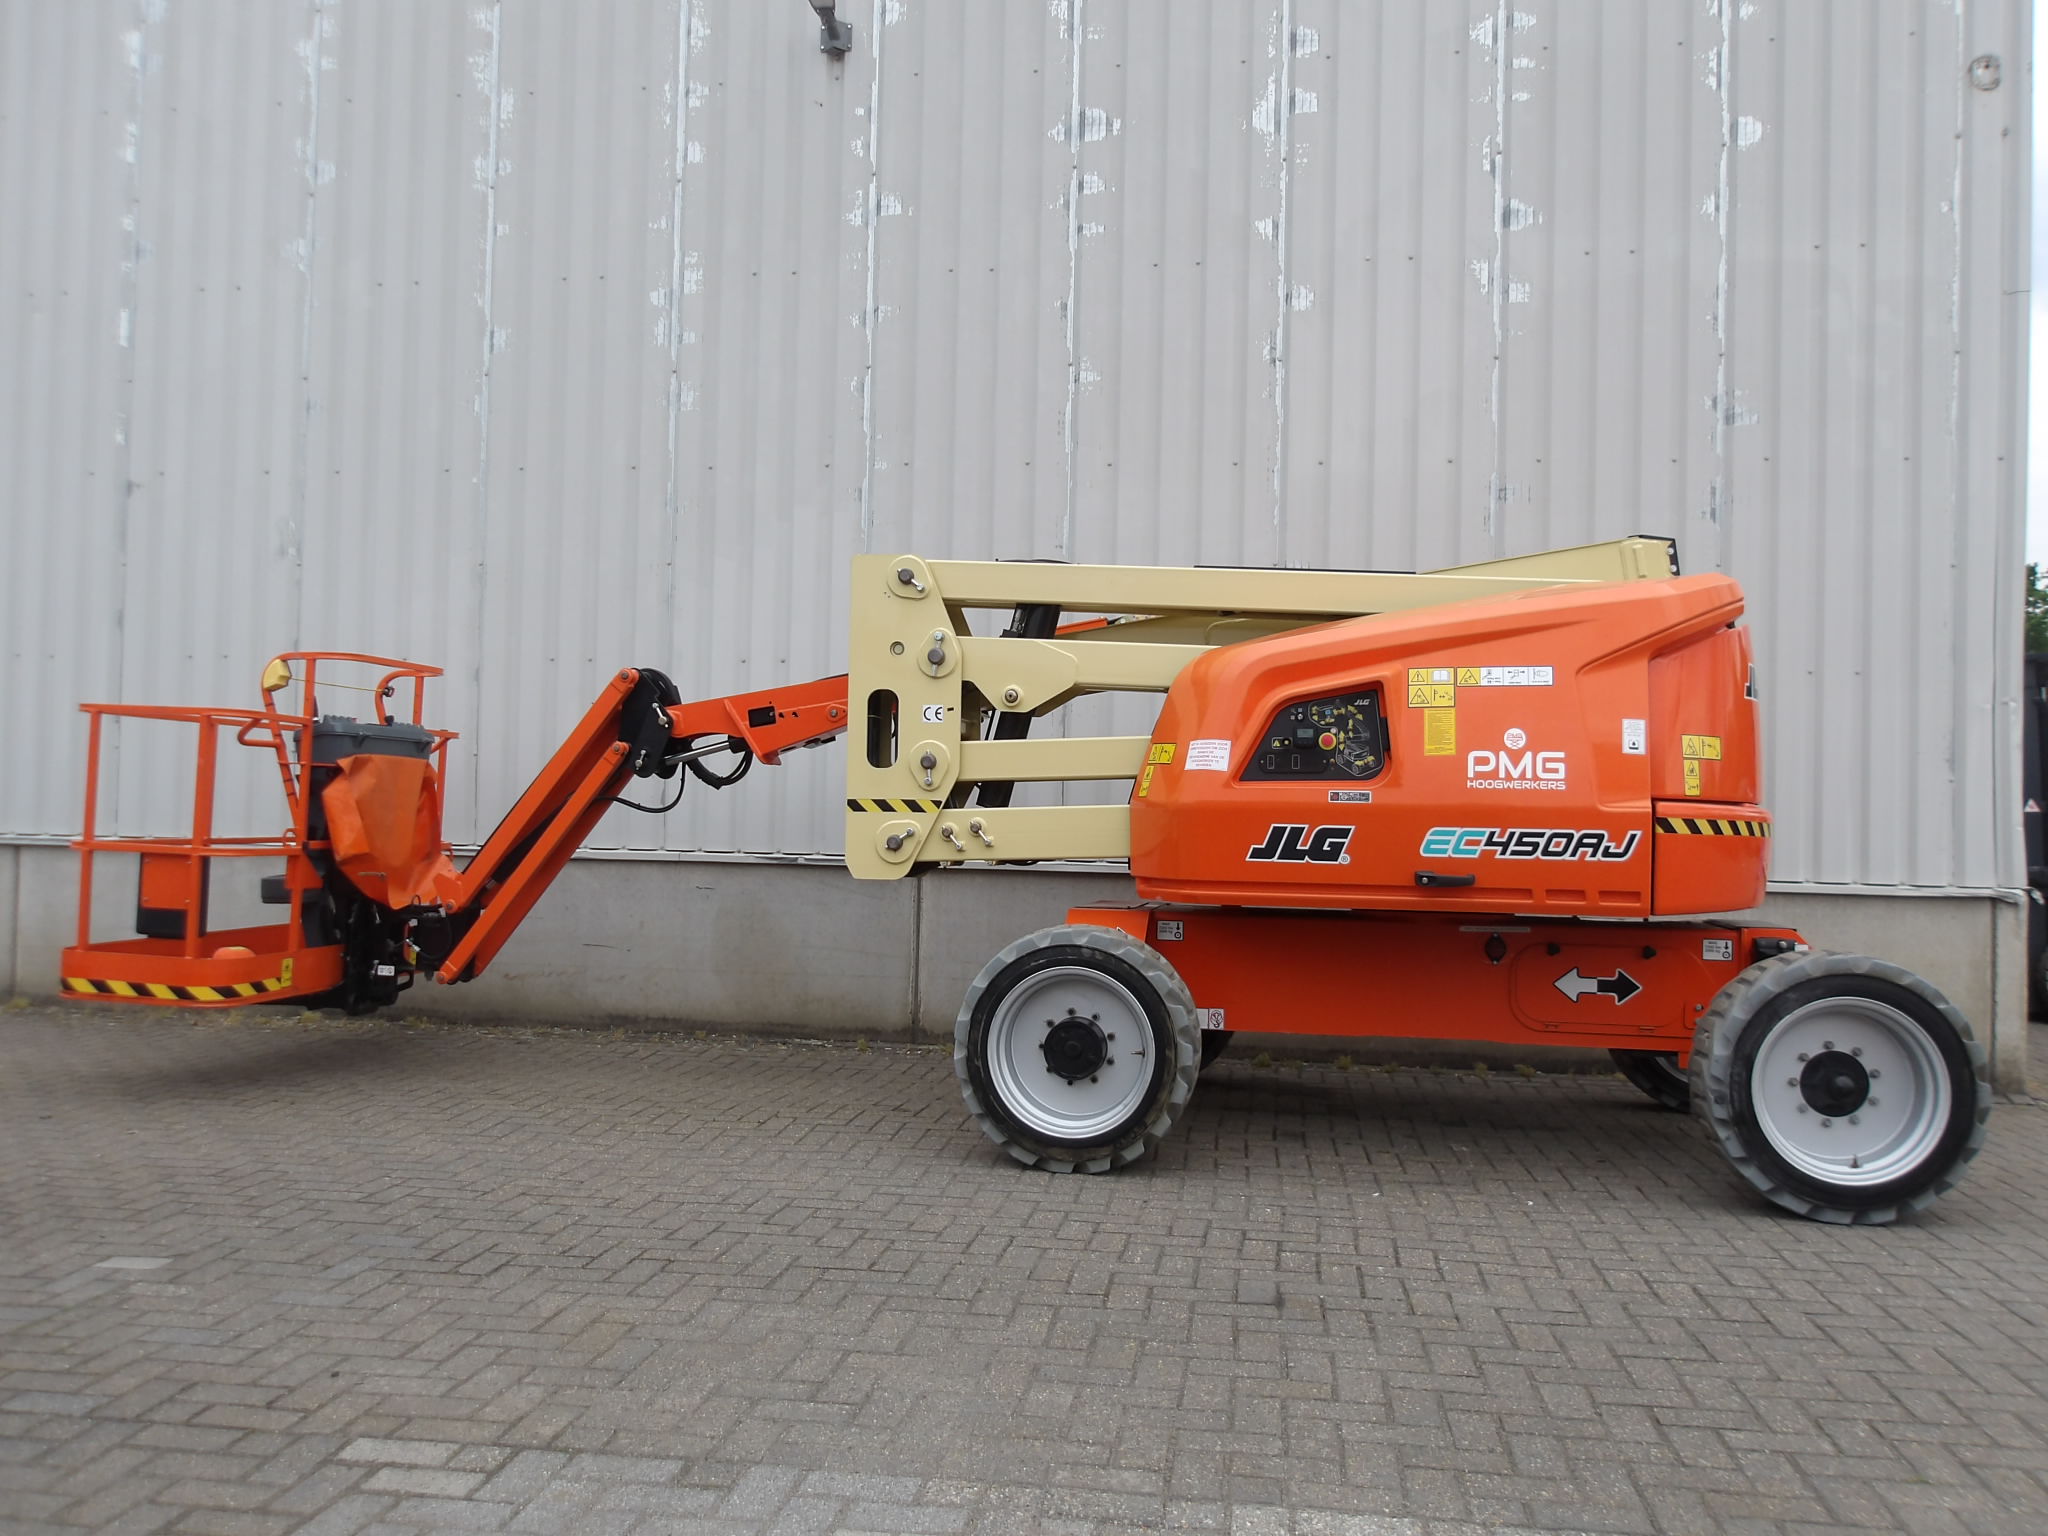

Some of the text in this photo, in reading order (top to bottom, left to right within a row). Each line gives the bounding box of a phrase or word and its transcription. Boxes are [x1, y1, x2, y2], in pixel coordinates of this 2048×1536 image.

[923, 706, 943, 721] CE
[1467, 750, 1565, 779] PMG
[1466, 779, 1566, 790] HOOGWERKERS
[1246, 824, 1355, 864] JLG
[1420, 827, 1642, 861] EC450AJ
